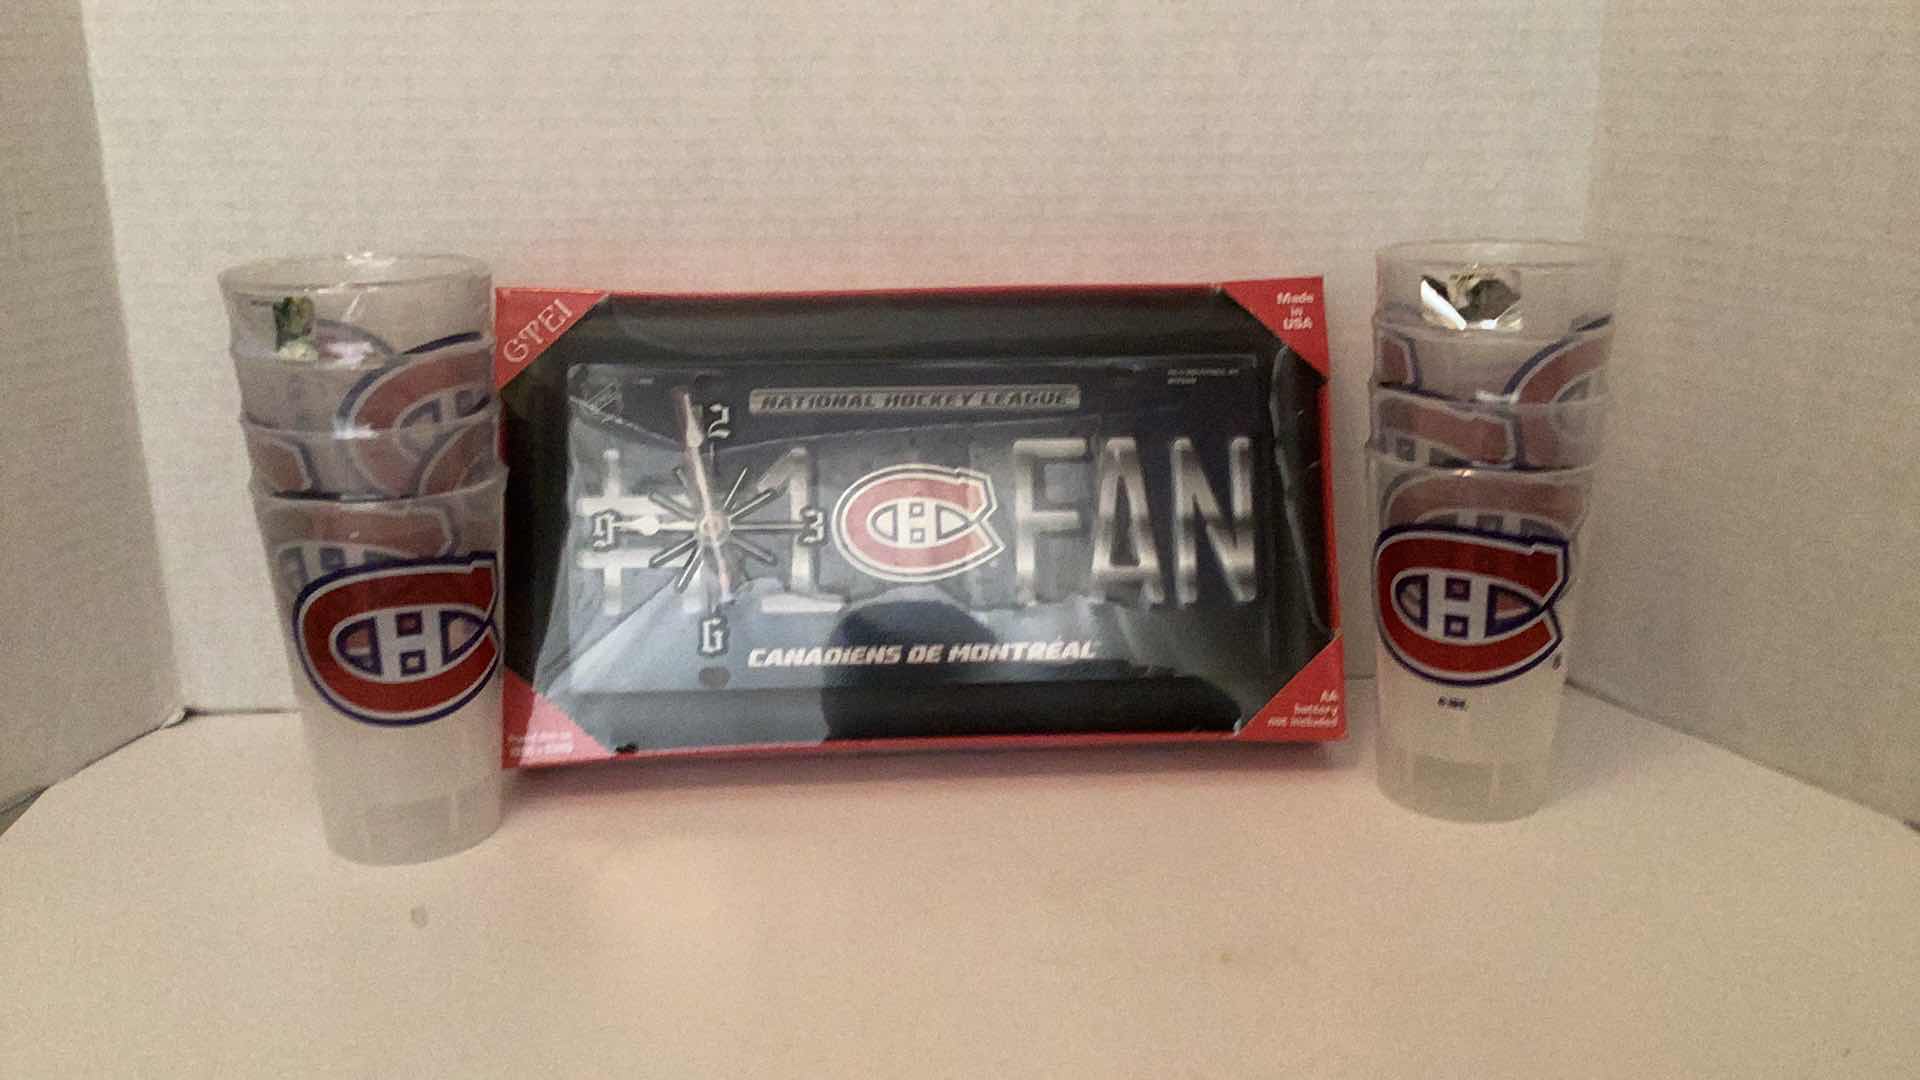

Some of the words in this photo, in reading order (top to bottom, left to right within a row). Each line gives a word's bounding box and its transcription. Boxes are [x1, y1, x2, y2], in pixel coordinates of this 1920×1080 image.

[1276, 291, 1314, 305] Made
[1290, 306, 1304, 317] in
[1283, 316, 1312, 331] USA
[760, 394, 874, 410] NATIONAL
[883, 392, 973, 409] HOCKEY
[979, 391, 1070, 408] LEAGUE
[801, 508, 824, 544] 3
[1012, 436, 1258, 607] FAN
[747, 645, 903, 669] CANADIENS
[906, 643, 945, 664] DE
[947, 635, 1097, 663] MONTRÉAL
[1320, 689, 1338, 703] AA
[1294, 702, 1338, 719] battery
[1267, 717, 1288, 728] not
[1290, 715, 1338, 729] included
